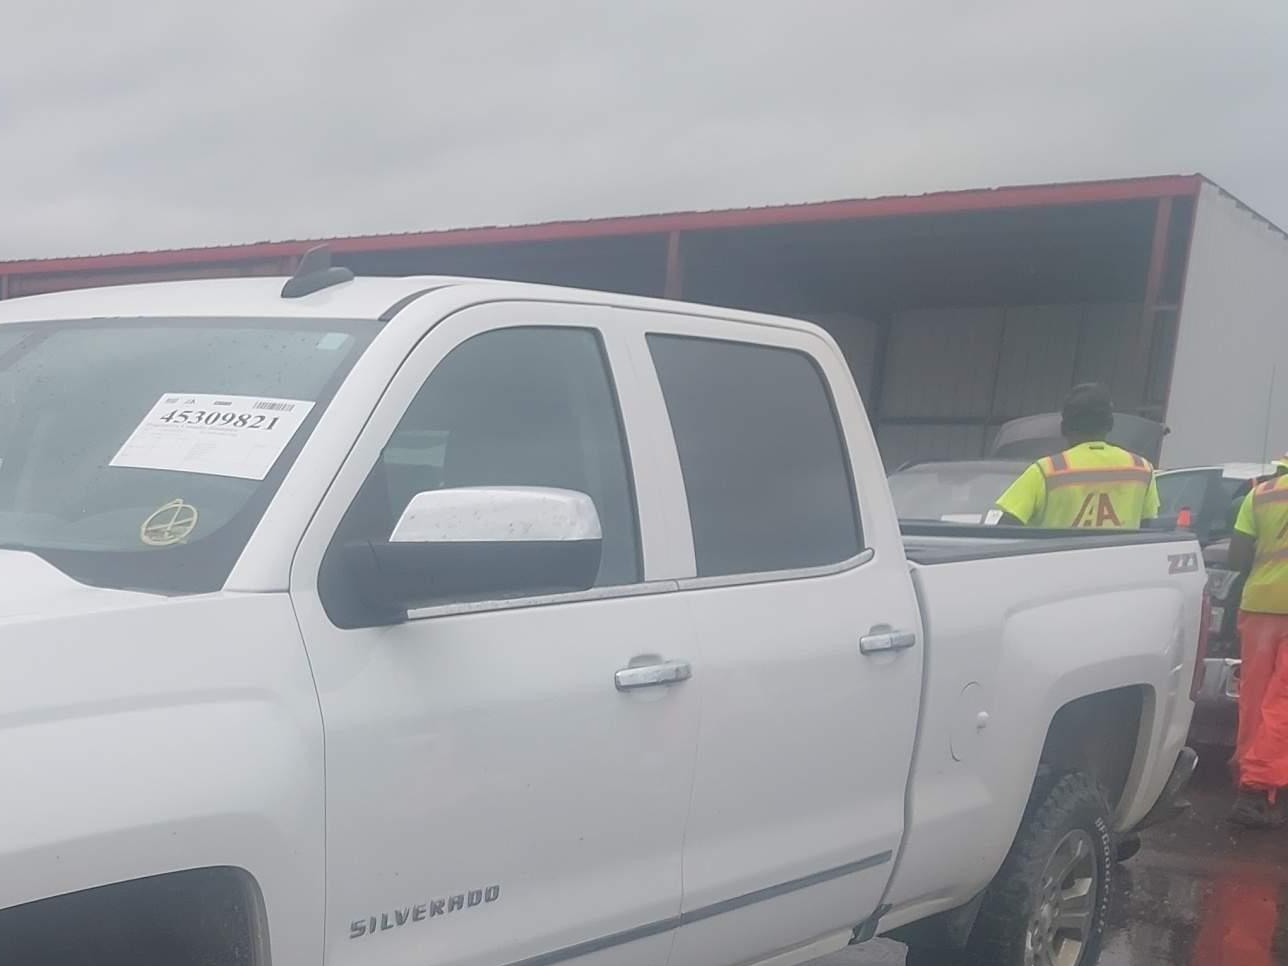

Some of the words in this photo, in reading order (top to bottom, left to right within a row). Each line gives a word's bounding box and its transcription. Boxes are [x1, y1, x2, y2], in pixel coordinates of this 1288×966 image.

[160, 409, 280, 431] 45309821
[1167, 552, 1199, 575] Z71
[349, 885, 501, 940] SILVERADO
